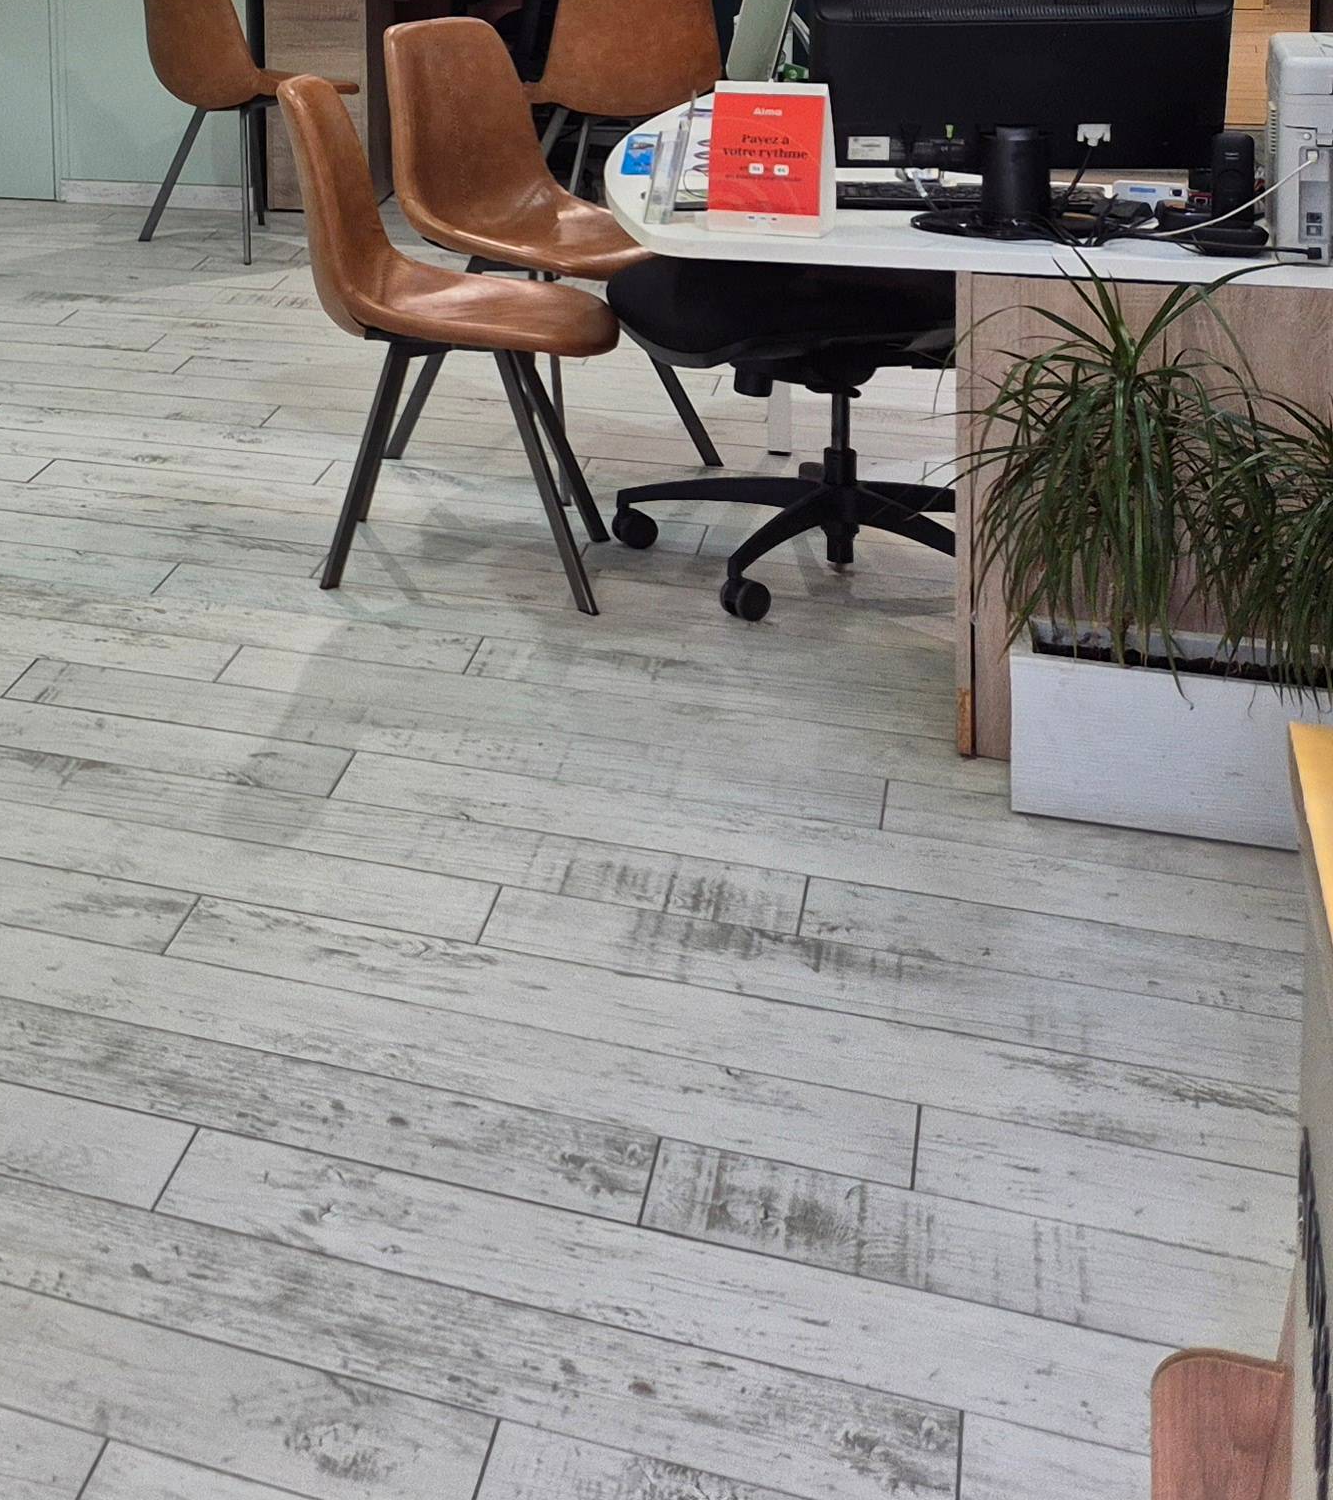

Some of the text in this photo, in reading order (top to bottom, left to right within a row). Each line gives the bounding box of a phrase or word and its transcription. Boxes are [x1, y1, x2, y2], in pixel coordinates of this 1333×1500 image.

[753, 107, 783, 117] Alma
[741, 134, 780, 145] Payez
[722, 147, 808, 160] votre rythme
